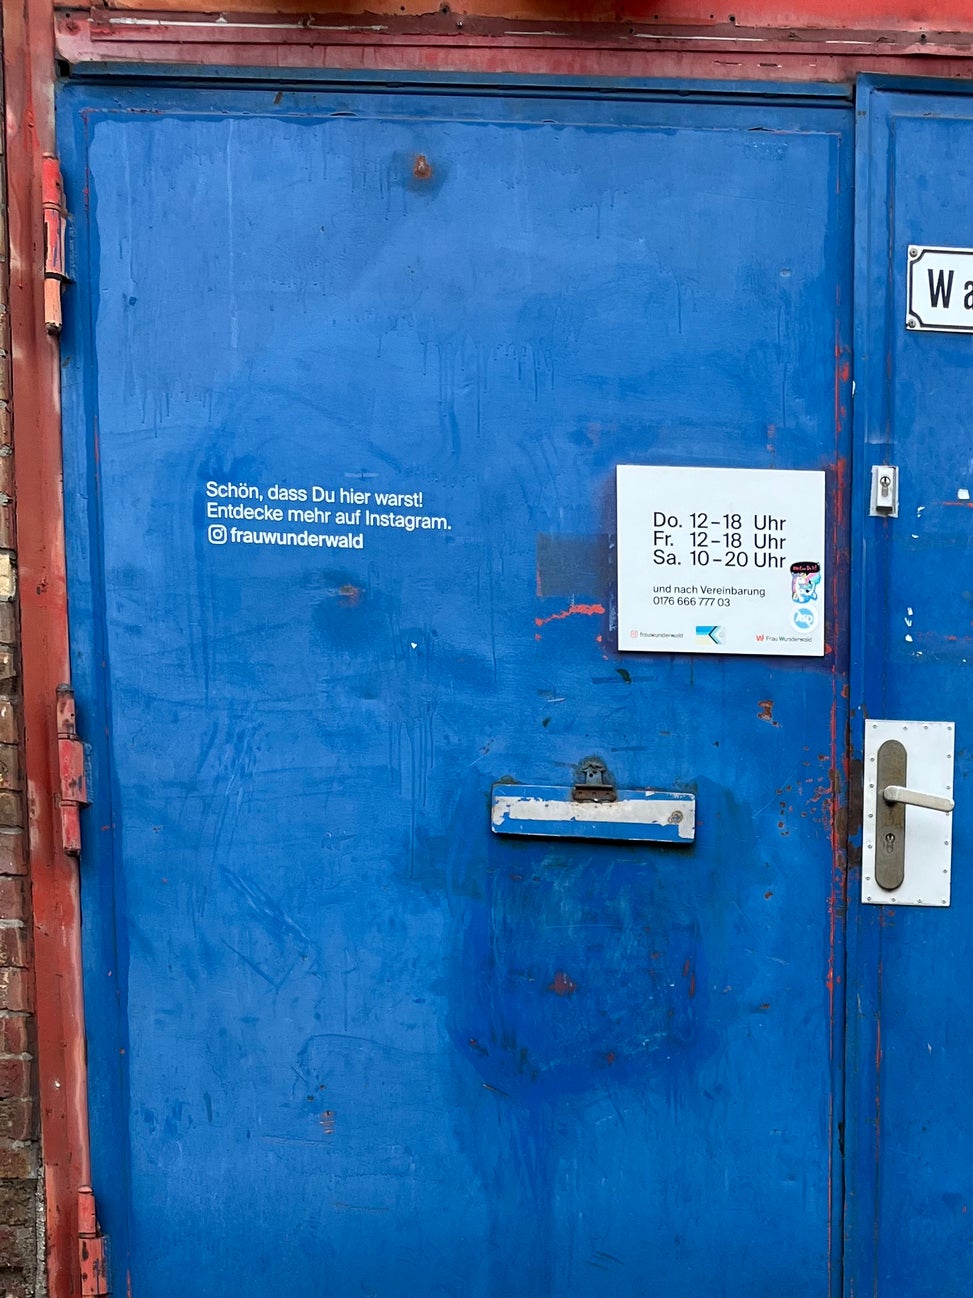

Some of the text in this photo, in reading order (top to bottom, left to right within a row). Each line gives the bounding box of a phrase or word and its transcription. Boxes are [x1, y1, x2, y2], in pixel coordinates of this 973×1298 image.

[206, 481, 423, 508] Schön, dass Du hier warst!
[207, 502, 452, 532] Entdecke mehr auf Instagram.
[653, 511, 683, 528] Do.
[754, 514, 787, 531] Uhr
[230, 527, 364, 549] frauwunderwald
[653, 530, 675, 547] Fr.
[754, 533, 787, 550] Uhr
[653, 549, 682, 566] Sa.
[754, 552, 787, 568] Uhr
[653, 585, 766, 598] und nach Vereinbarung
[653, 597, 731, 607] 0176 666 777 03
